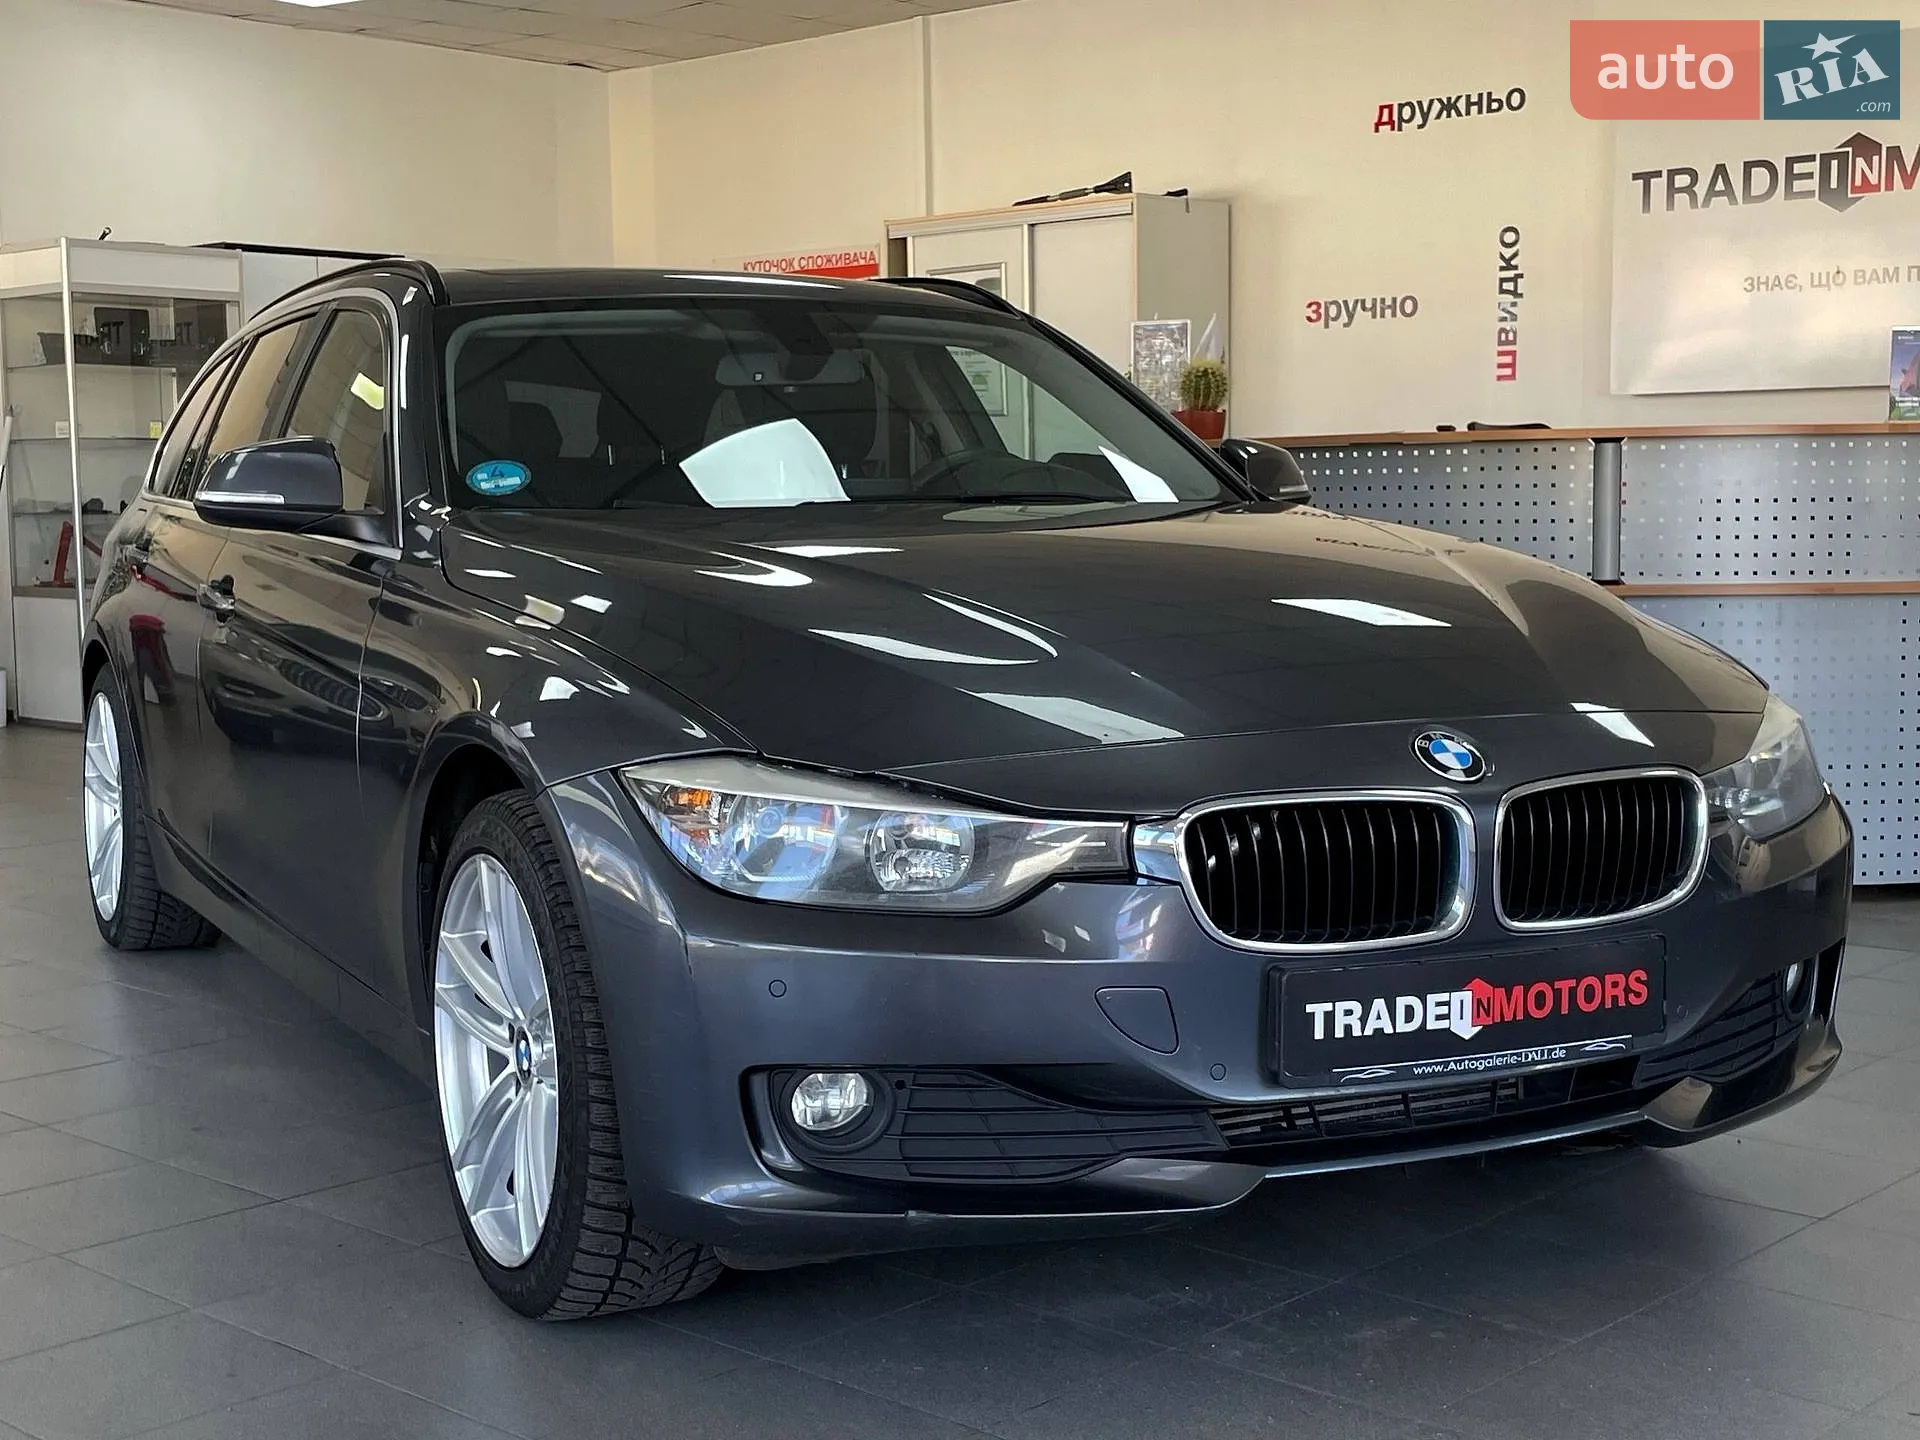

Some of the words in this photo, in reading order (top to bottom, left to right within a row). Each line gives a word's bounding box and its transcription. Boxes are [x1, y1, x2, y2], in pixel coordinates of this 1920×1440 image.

[1374, 87, 1526, 133] дружньо
[798, 250, 877, 270] СПОЖИВАЧА
[1743, 274, 1803, 293] ЗНАЄ,
[1810, 270, 1846, 291] ЩО
[1853, 266, 1900, 286] ВАМ
[1305, 295, 1418, 329] зручно
